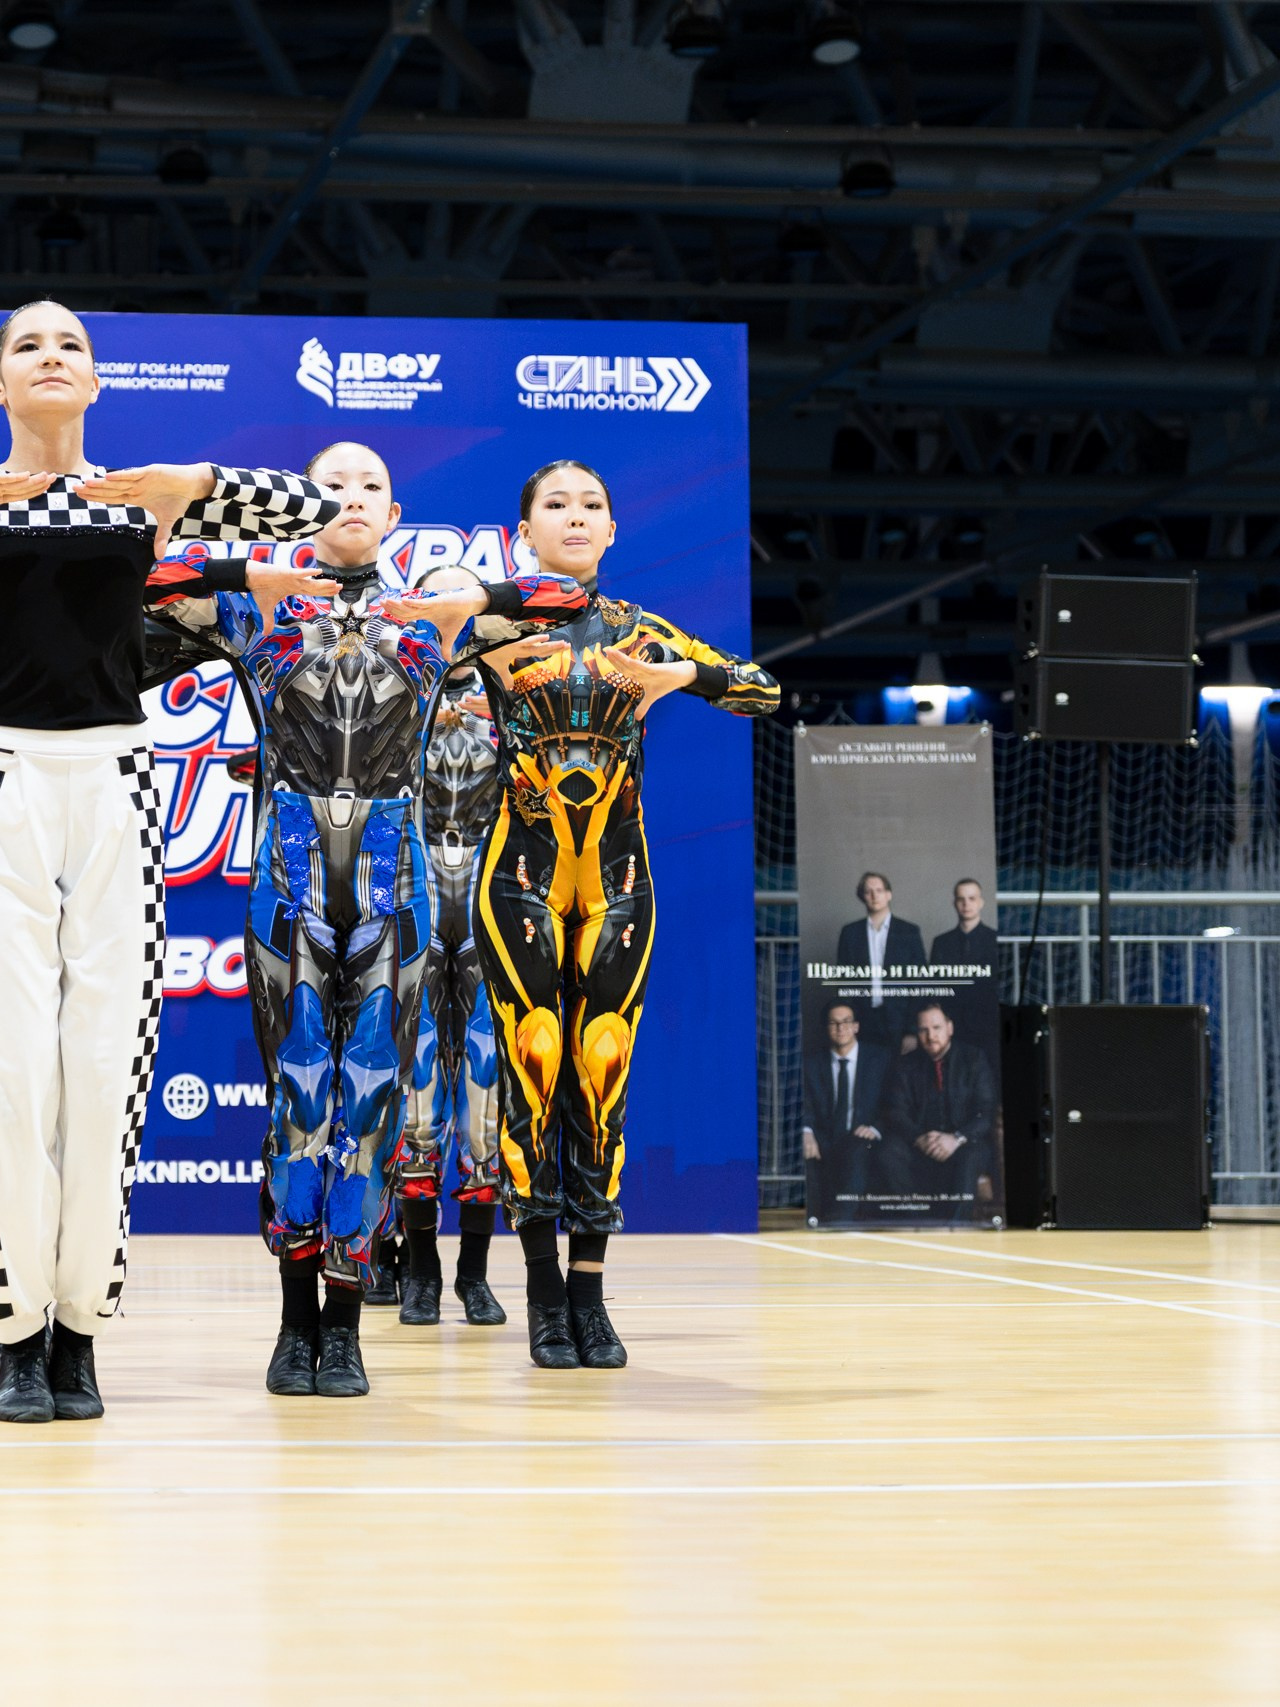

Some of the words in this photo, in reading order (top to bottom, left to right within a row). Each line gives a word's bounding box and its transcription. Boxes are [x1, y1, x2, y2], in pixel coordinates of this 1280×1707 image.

[336, 352, 441, 381] ДВФУ
[516, 354, 657, 393] СТАНЬ
[100, 376, 189, 391] РИМОРСКОМ
[517, 392, 658, 411] ЧЕМПИОНОМ
